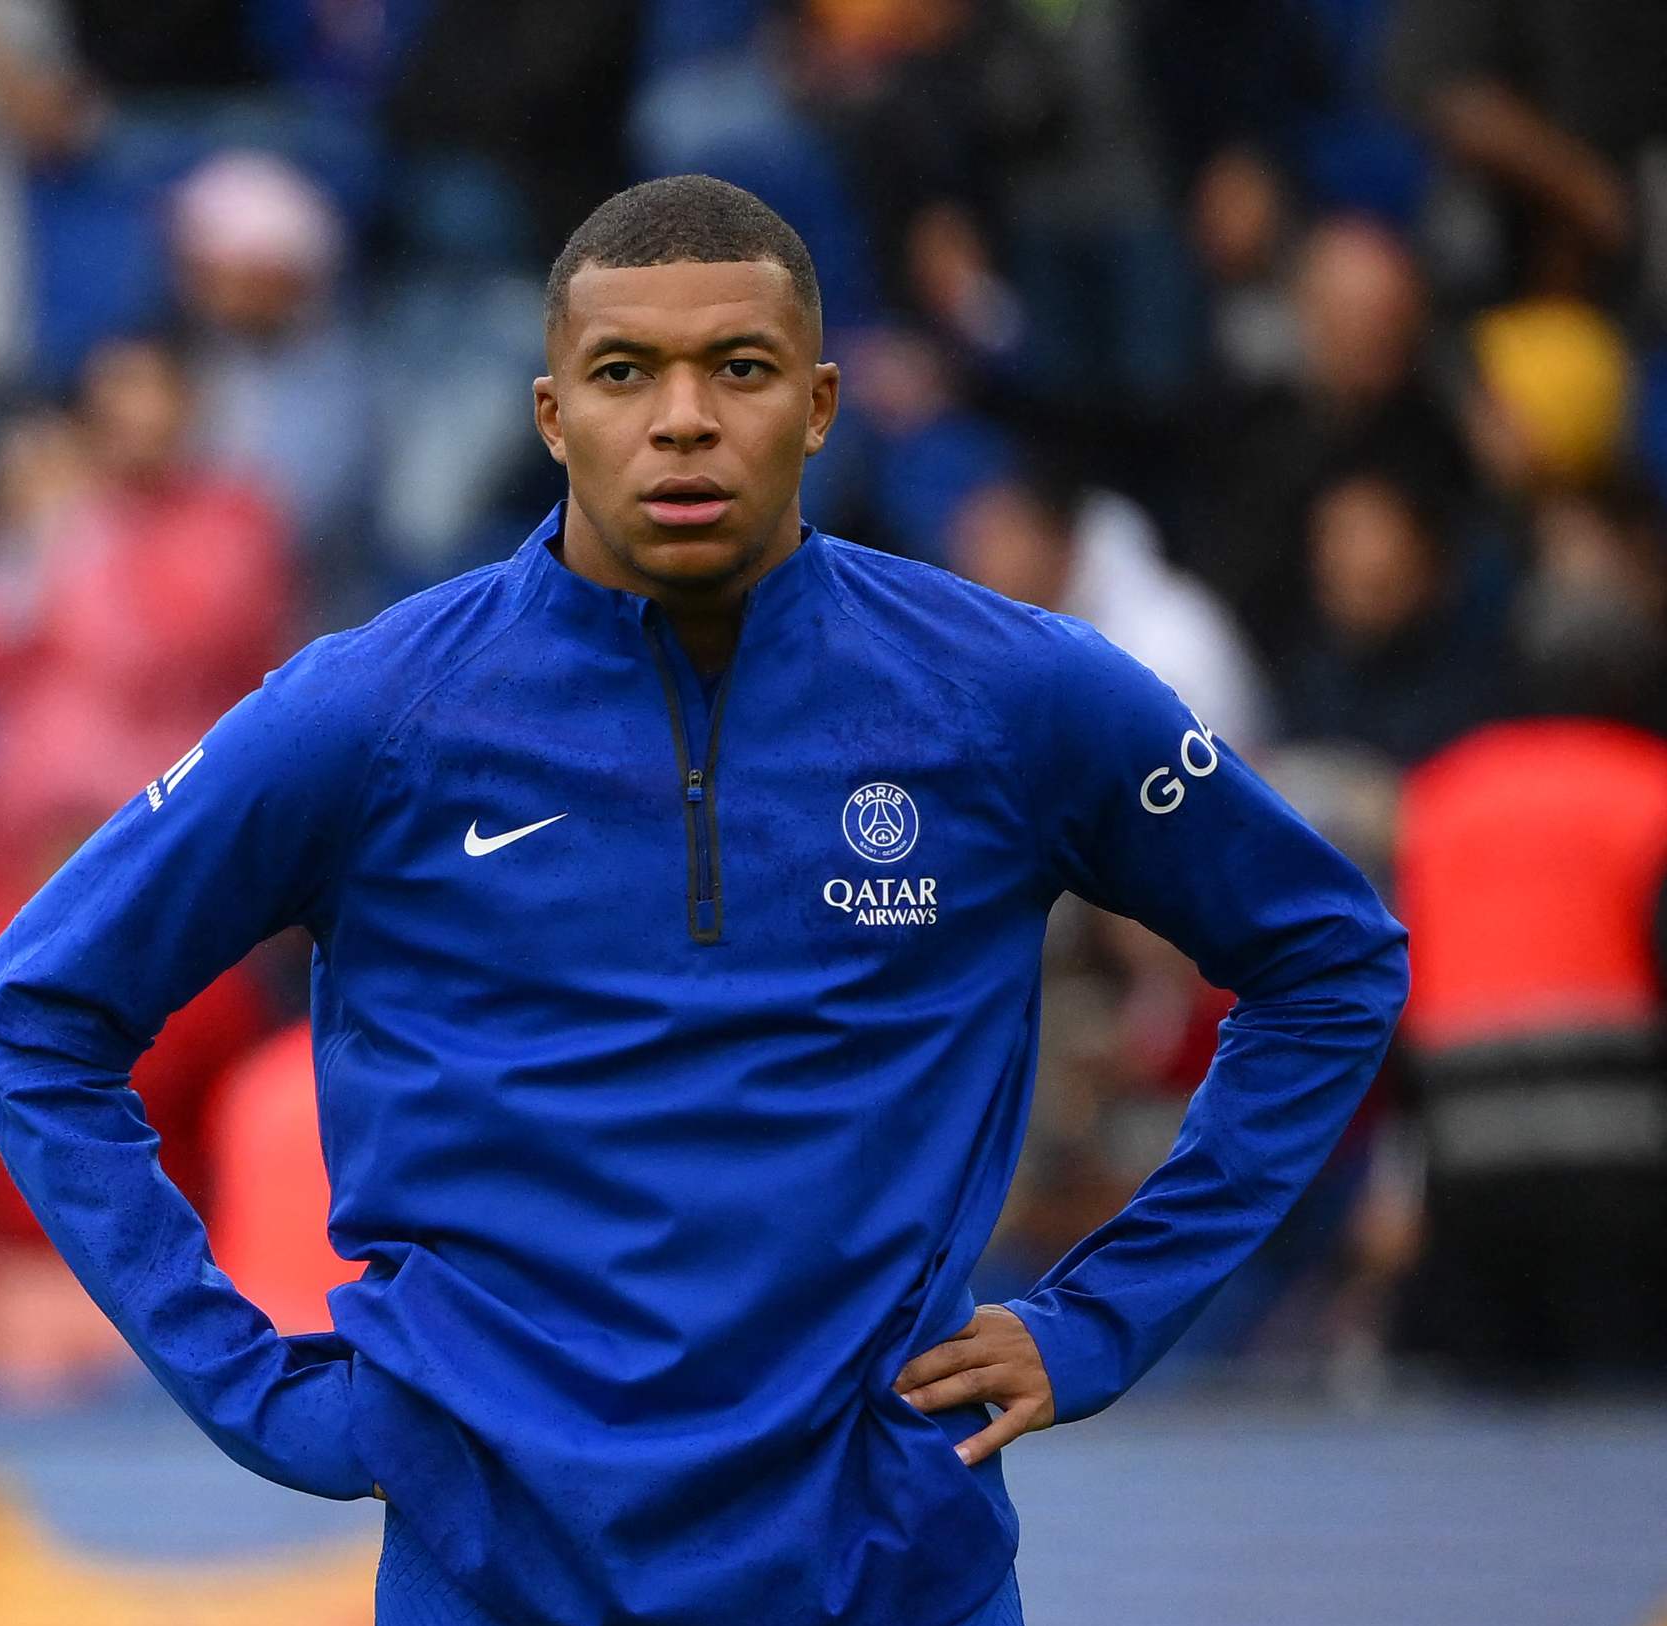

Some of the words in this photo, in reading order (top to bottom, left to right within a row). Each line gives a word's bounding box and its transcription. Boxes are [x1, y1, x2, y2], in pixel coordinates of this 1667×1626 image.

[853, 786, 904, 807] PARIS
[823, 877, 938, 913] QATAR
[855, 907, 937, 925] AIRWAYS
